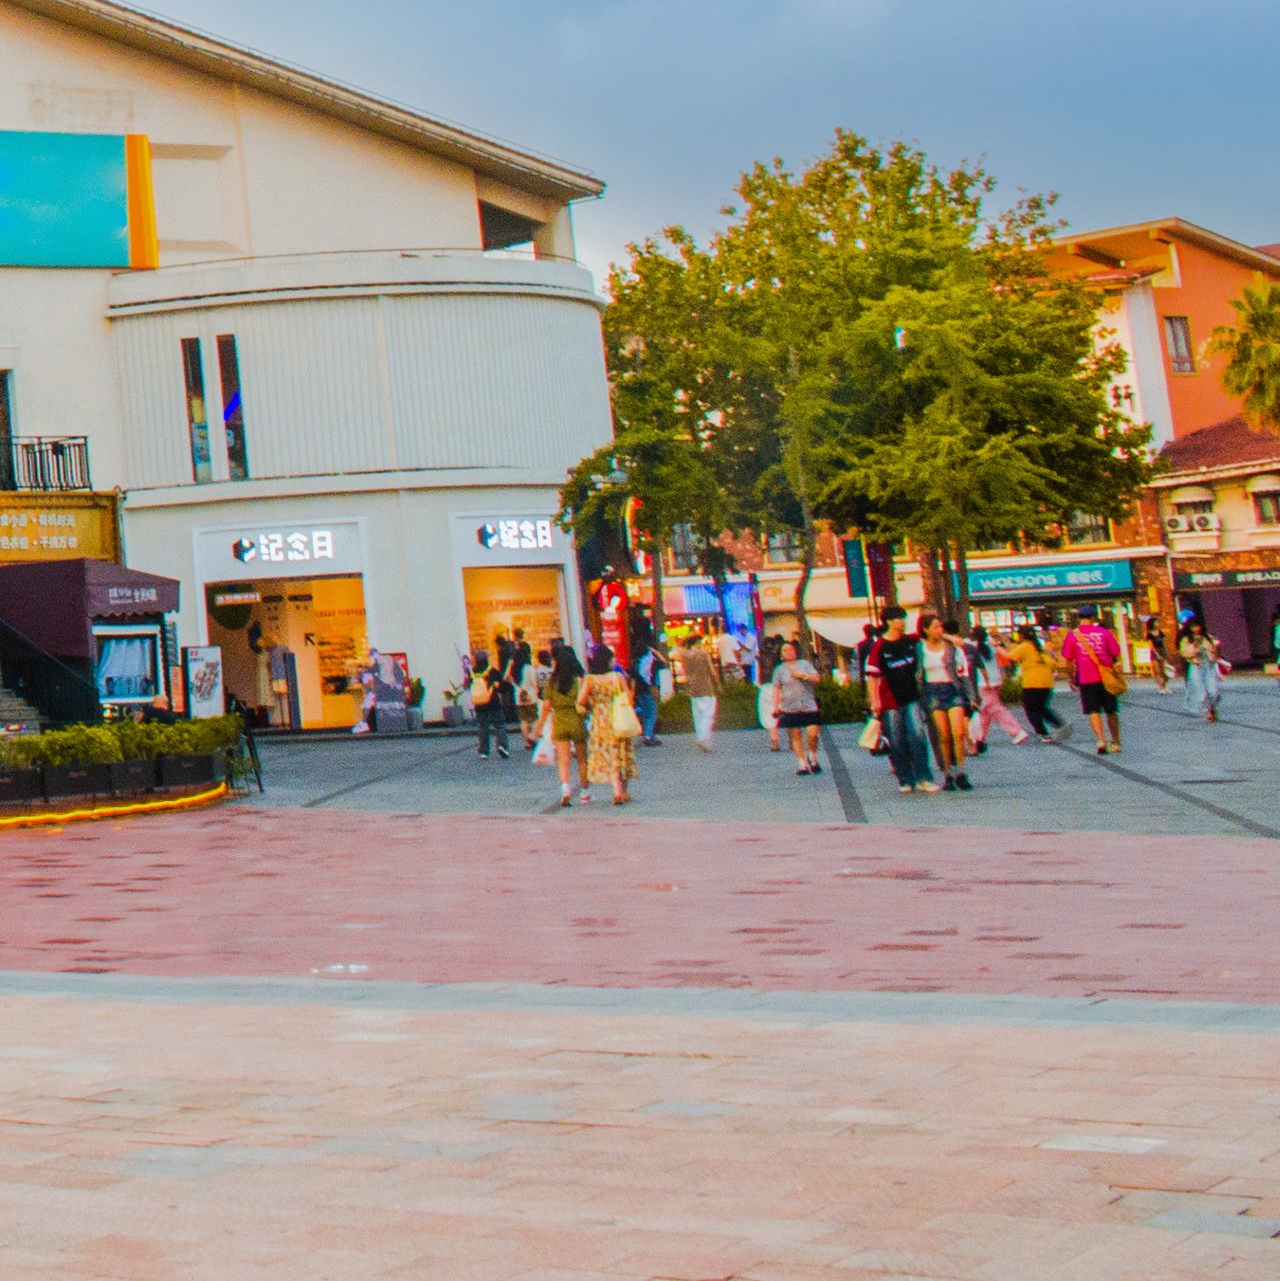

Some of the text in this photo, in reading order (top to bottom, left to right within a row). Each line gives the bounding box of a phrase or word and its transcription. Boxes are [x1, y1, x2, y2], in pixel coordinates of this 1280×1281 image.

[259, 530, 334, 562] 纪念日
[499, 520, 552, 548] 纪念日
[981, 574, 1058, 589] watsons
